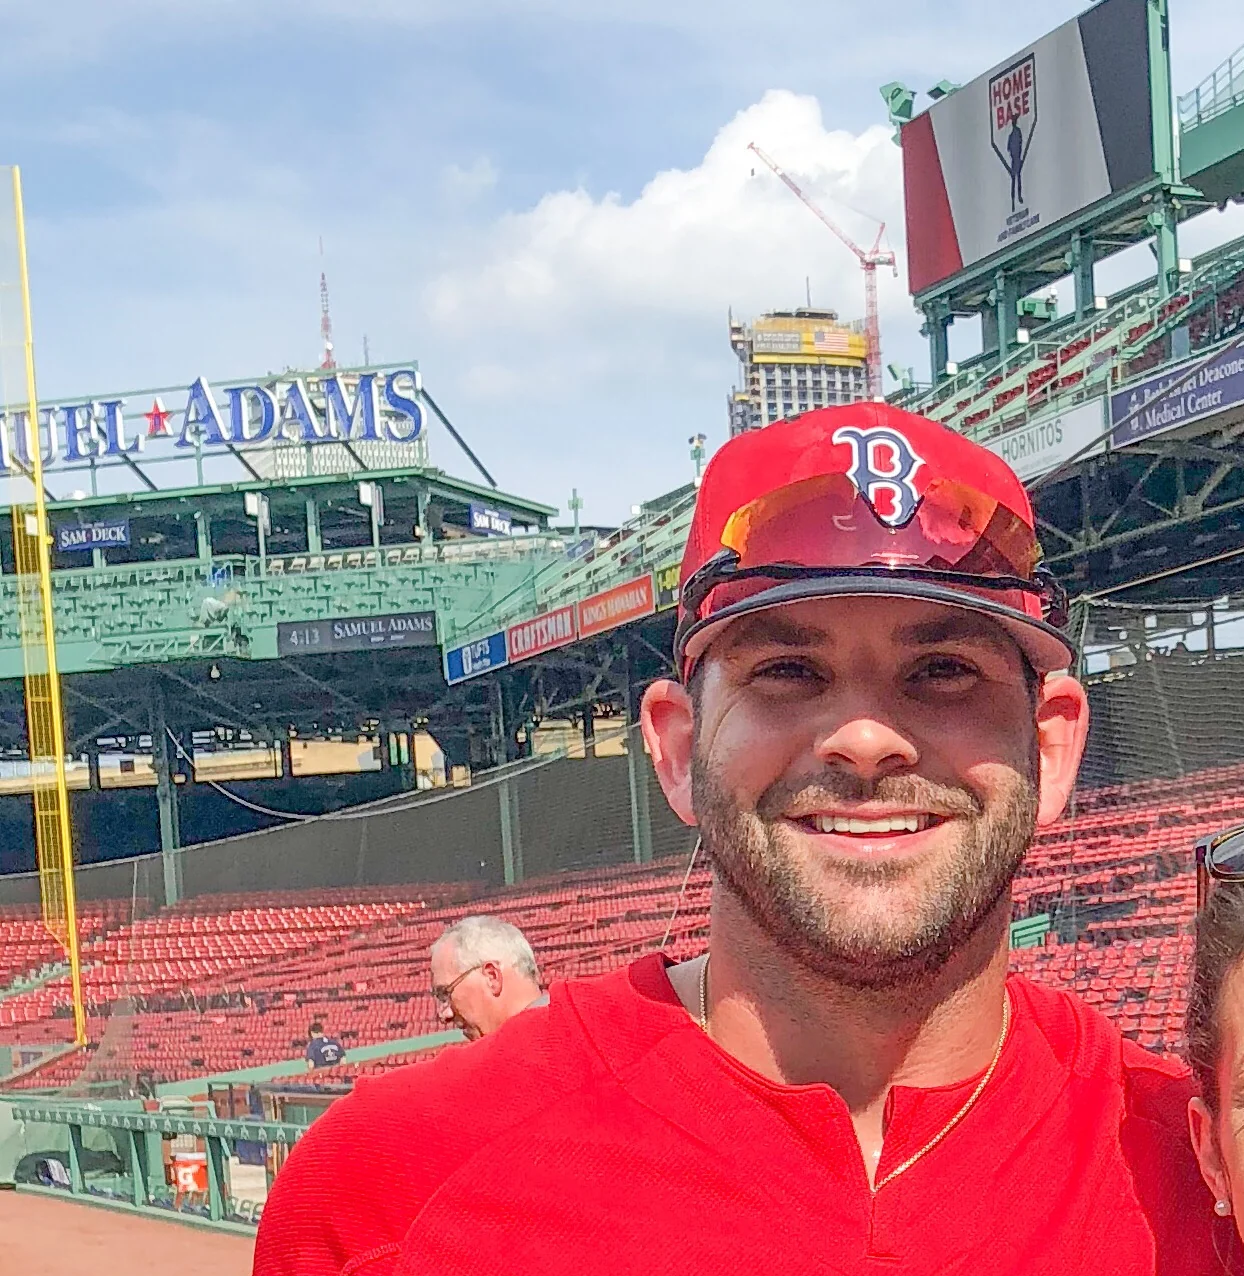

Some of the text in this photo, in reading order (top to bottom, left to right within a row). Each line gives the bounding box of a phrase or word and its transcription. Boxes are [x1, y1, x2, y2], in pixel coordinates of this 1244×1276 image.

[992, 64, 1032, 107] HOME
[996, 90, 1030, 130] BASE
[0, 370, 428, 468] UEL ADAMS
[1145, 390, 1223, 430] Medical Center
[1001, 418, 1063, 463] HORNITOS
[832, 426, 926, 527] B
[60, 525, 127, 548] SAM DECK
[333, 621, 386, 640] SAMUEL
[388, 616, 433, 632] ADAMS
[511, 610, 572, 656] CRAFTSMAN
